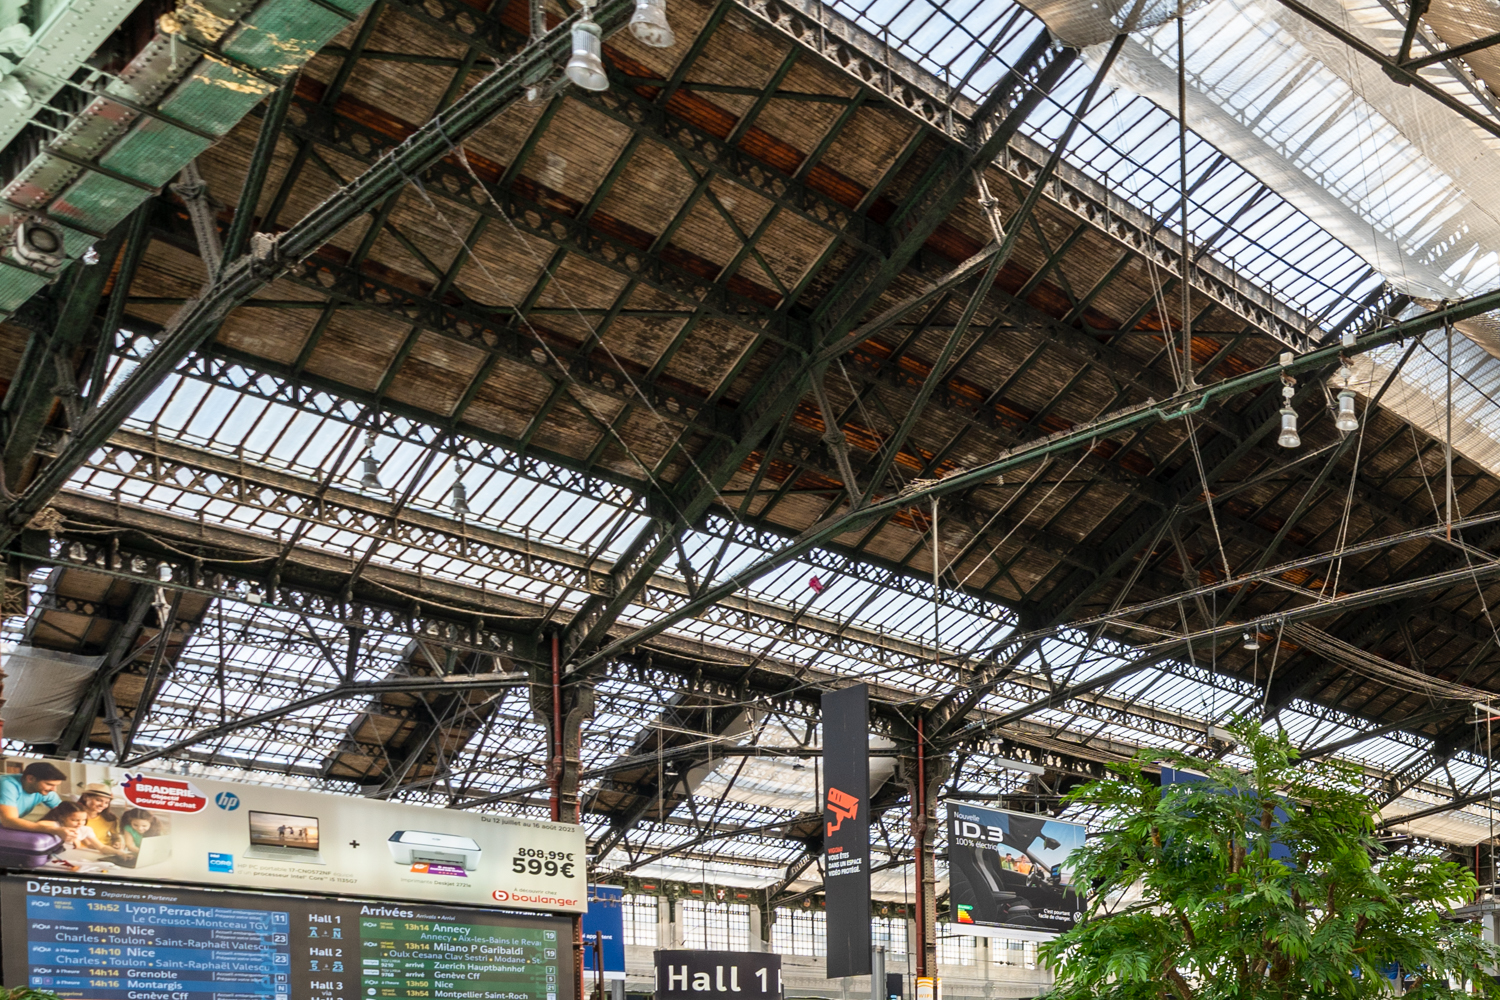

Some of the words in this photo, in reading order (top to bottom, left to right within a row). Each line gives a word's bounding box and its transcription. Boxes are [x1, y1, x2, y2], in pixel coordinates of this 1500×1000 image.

[136, 784, 195, 798] BRADERIE
[136, 798, 166, 806] pouvoir
[167, 801, 196, 809] d'achat
[218, 792, 238, 811] hp
[954, 811, 980, 821] Nouvelle
[541, 823, 557, 831] août
[954, 820, 1003, 843] ID.3
[956, 838, 974, 848] 100%
[517, 848, 575, 862] 808,99€
[512, 857, 575, 878] 599€
[847, 858, 862, 866] ESPACE
[27, 880, 96, 896] Départs
[101, 891, 140, 899] Departures
[512, 893, 578, 906] boulanger
[87, 903, 120, 912] 13h52
[126, 904, 155, 915] Lyon
[360, 905, 414, 918] Arrivées
[133, 915, 145, 923] Le
[148, 916, 247, 929] Creusot-Montceau
[309, 914, 332, 923] Hall
[335, 916, 341, 924] 1
[88, 925, 121, 934] 14h10
[126, 926, 155, 936] Nice
[433, 924, 470, 935] Annecy
[55, 933, 99, 943] Charles
[109, 935, 145, 945] Toulon
[155, 938, 230, 950] Saint-Raphaël
[421, 933, 452, 942] Annecy
[458, 935, 510, 945] Aix-les-Bains
[89, 947, 121, 956] 14h10
[127, 948, 156, 957] Nice
[309, 948, 333, 956] Hall
[433, 943, 468, 953] Milano
[471, 945, 478, 953] P
[480, 945, 523, 955] Garibaldi
[56, 955, 100, 965] Charles
[109, 957, 146, 966] Toulon
[156, 960, 230, 970] Saint-Raphaël
[389, 950, 410, 958] Oulx
[412, 951, 443, 959] Cesana
[444, 952, 463, 960] Clav
[464, 953, 488, 962] Sestri
[494, 955, 526, 964] Modane
[434, 962, 465, 970] Zuerich
[468, 963, 525, 973] Hauptbahnhof
[89, 969, 119, 977] 14h14
[127, 969, 177, 979] Grenoble
[434, 971, 465, 979] Genève
[669, 965, 741, 992] Hall
[755, 968, 768, 993] 1
[89, 980, 120, 988] 14h16
[128, 980, 182, 991] Montargis
[310, 981, 334, 990] Hall
[336, 982, 343, 990] 3
[128, 991, 169, 1000] Genève
[172, 992, 188, 1000] Cff
[435, 991, 482, 999] Montpellier
[485, 992, 528, 1000] Saint-Roch
